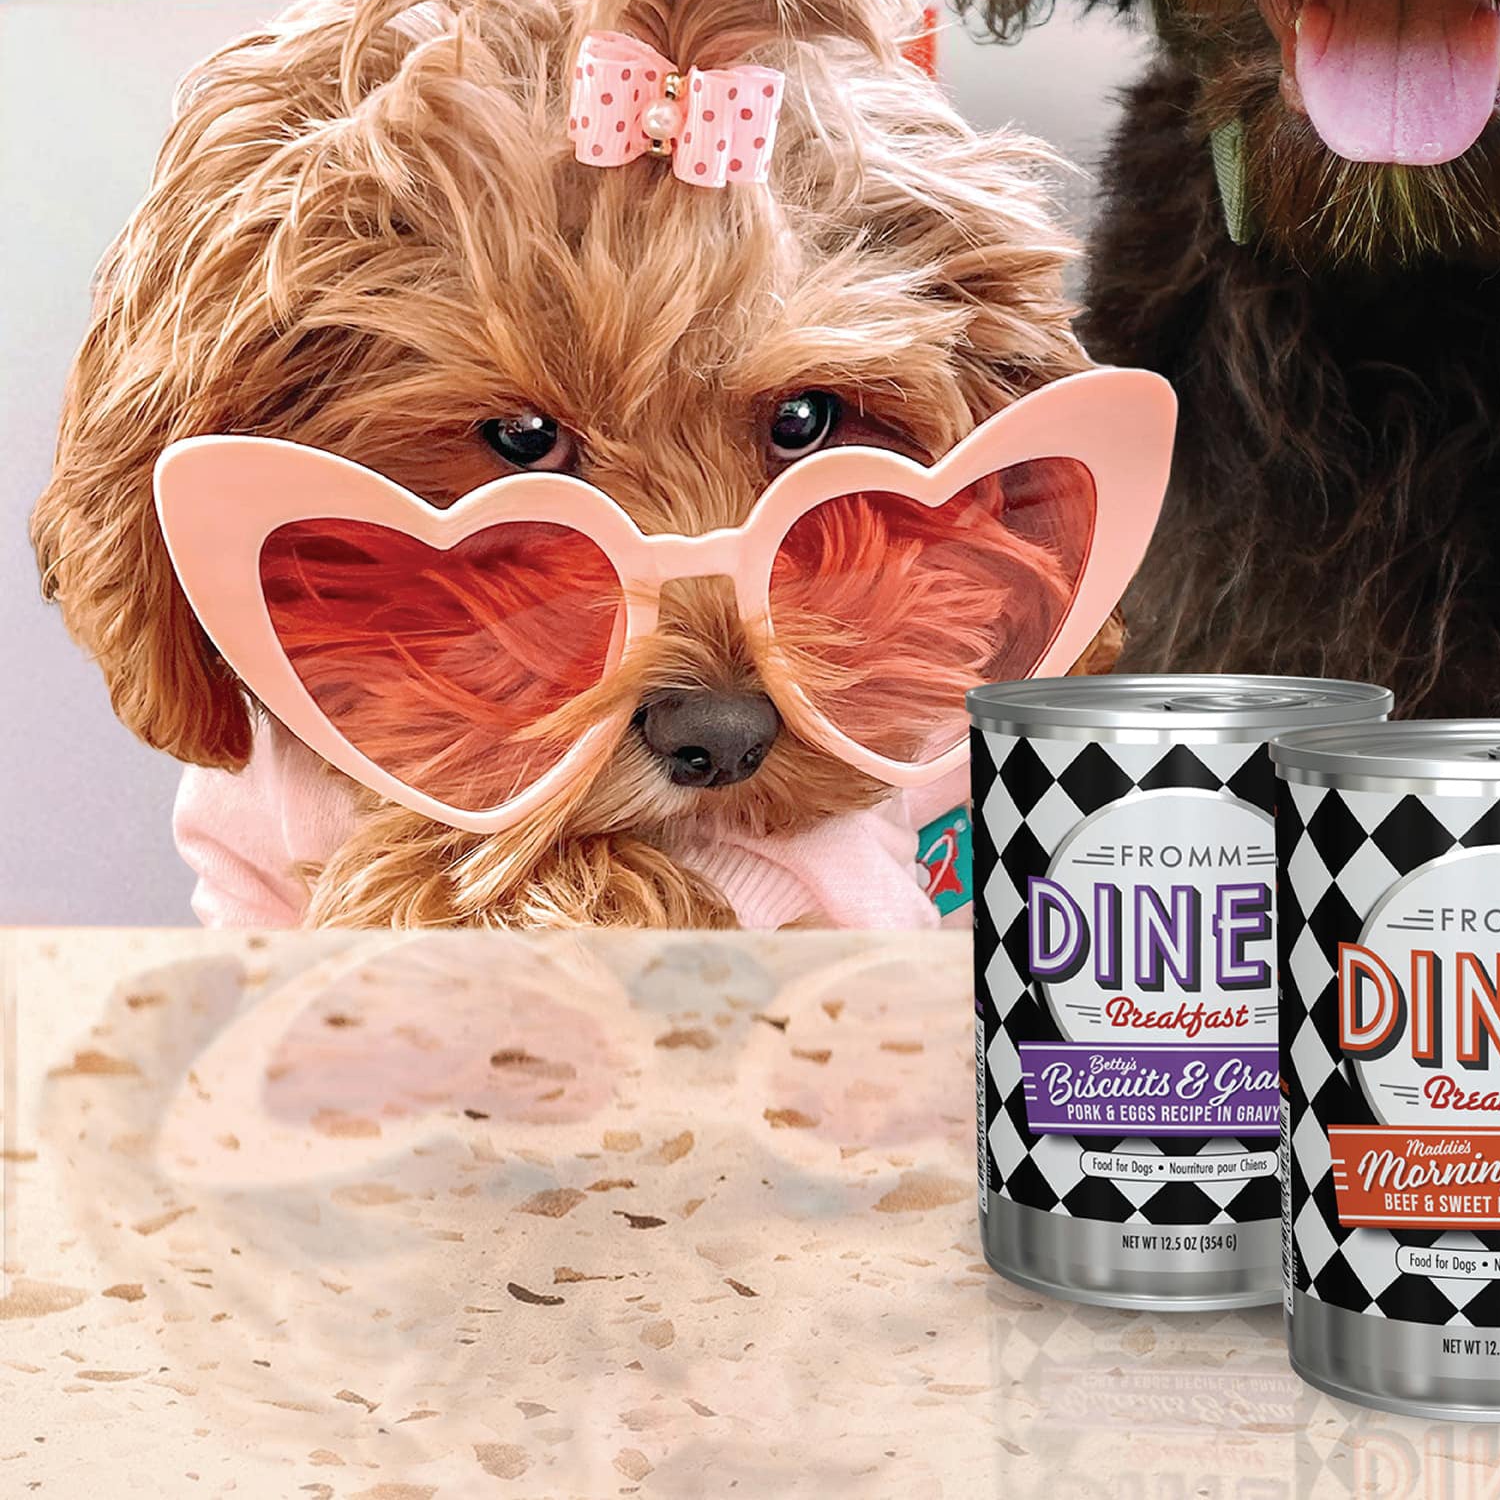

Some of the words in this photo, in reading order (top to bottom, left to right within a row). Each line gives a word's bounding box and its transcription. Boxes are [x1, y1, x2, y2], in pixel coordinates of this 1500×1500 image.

[1121, 846, 1242, 868] FROMM
[1028, 875, 1273, 992] DINE
[1105, 997, 1249, 1038] Breakfast
[1089, 1054, 1137, 1075] Betty's
[1041, 1061, 1171, 1106] Biscuits
[1175, 1060, 1209, 1100] &
[1067, 1104, 1100, 1121] PORK
[1106, 1105, 1115, 1121] &
[1120, 1105, 1155, 1122] EGGS
[1161, 1106, 1212, 1122] RECIPE
[1217, 1106, 1232, 1122] IN
[1237, 1105, 1280, 1122] GRAVY
[1406, 1139, 1471, 1157] Maddie's
[1093, 1157, 1113, 1171] Food
[1116, 1158, 1128, 1172] for
[1132, 1160, 1153, 1175] Dogs
[1170, 1161, 1214, 1174] Nourriture
[1217, 1162, 1237, 1174] pour
[1240, 1159, 1268, 1171] Chiens
[1384, 1193, 1419, 1211] BEEF
[1424, 1194, 1434, 1212] &
[1439, 1195, 1490, 1213] SWEET
[1122, 1235, 1139, 1249] NET
[1142, 1236, 1157, 1250] WT
[1161, 1236, 1181, 1250] 12.5
[1184, 1236, 1197, 1250] OZ
[1200, 1235, 1223, 1253] (354
[1226, 1234, 1237, 1252] G)
[1409, 1253, 1431, 1268] Food
[1435, 1254, 1449, 1269] for
[1453, 1256, 1477, 1273] Dogs
[1443, 1339, 1461, 1353] NET
[1464, 1340, 1481, 1355] WT
